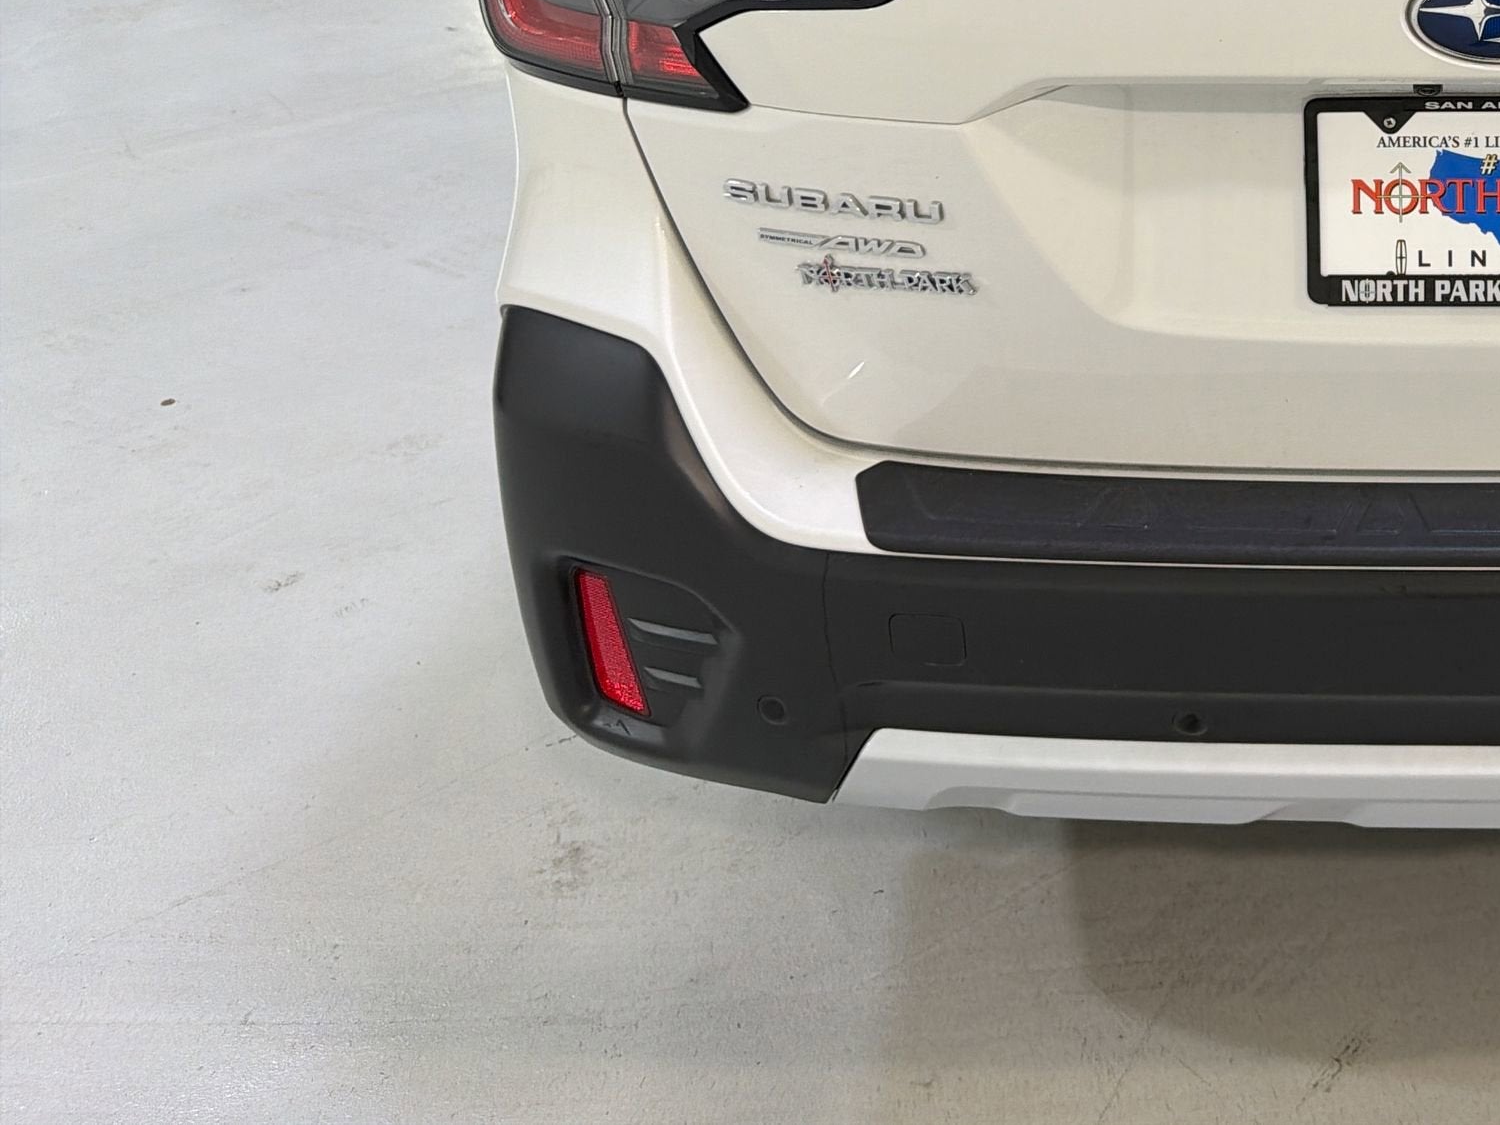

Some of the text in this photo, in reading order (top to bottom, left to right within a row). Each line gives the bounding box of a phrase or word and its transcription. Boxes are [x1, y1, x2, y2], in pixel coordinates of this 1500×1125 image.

[1425, 101, 1473, 110] SAN
[1376, 135, 1460, 149] AMERICA'S
[1464, 135, 1479, 149] #1
[724, 178, 944, 225] SUBARU
[818, 235, 926, 258] AWD
[798, 264, 978, 295] NORTH PARK
[1341, 279, 1425, 302] NORTH
